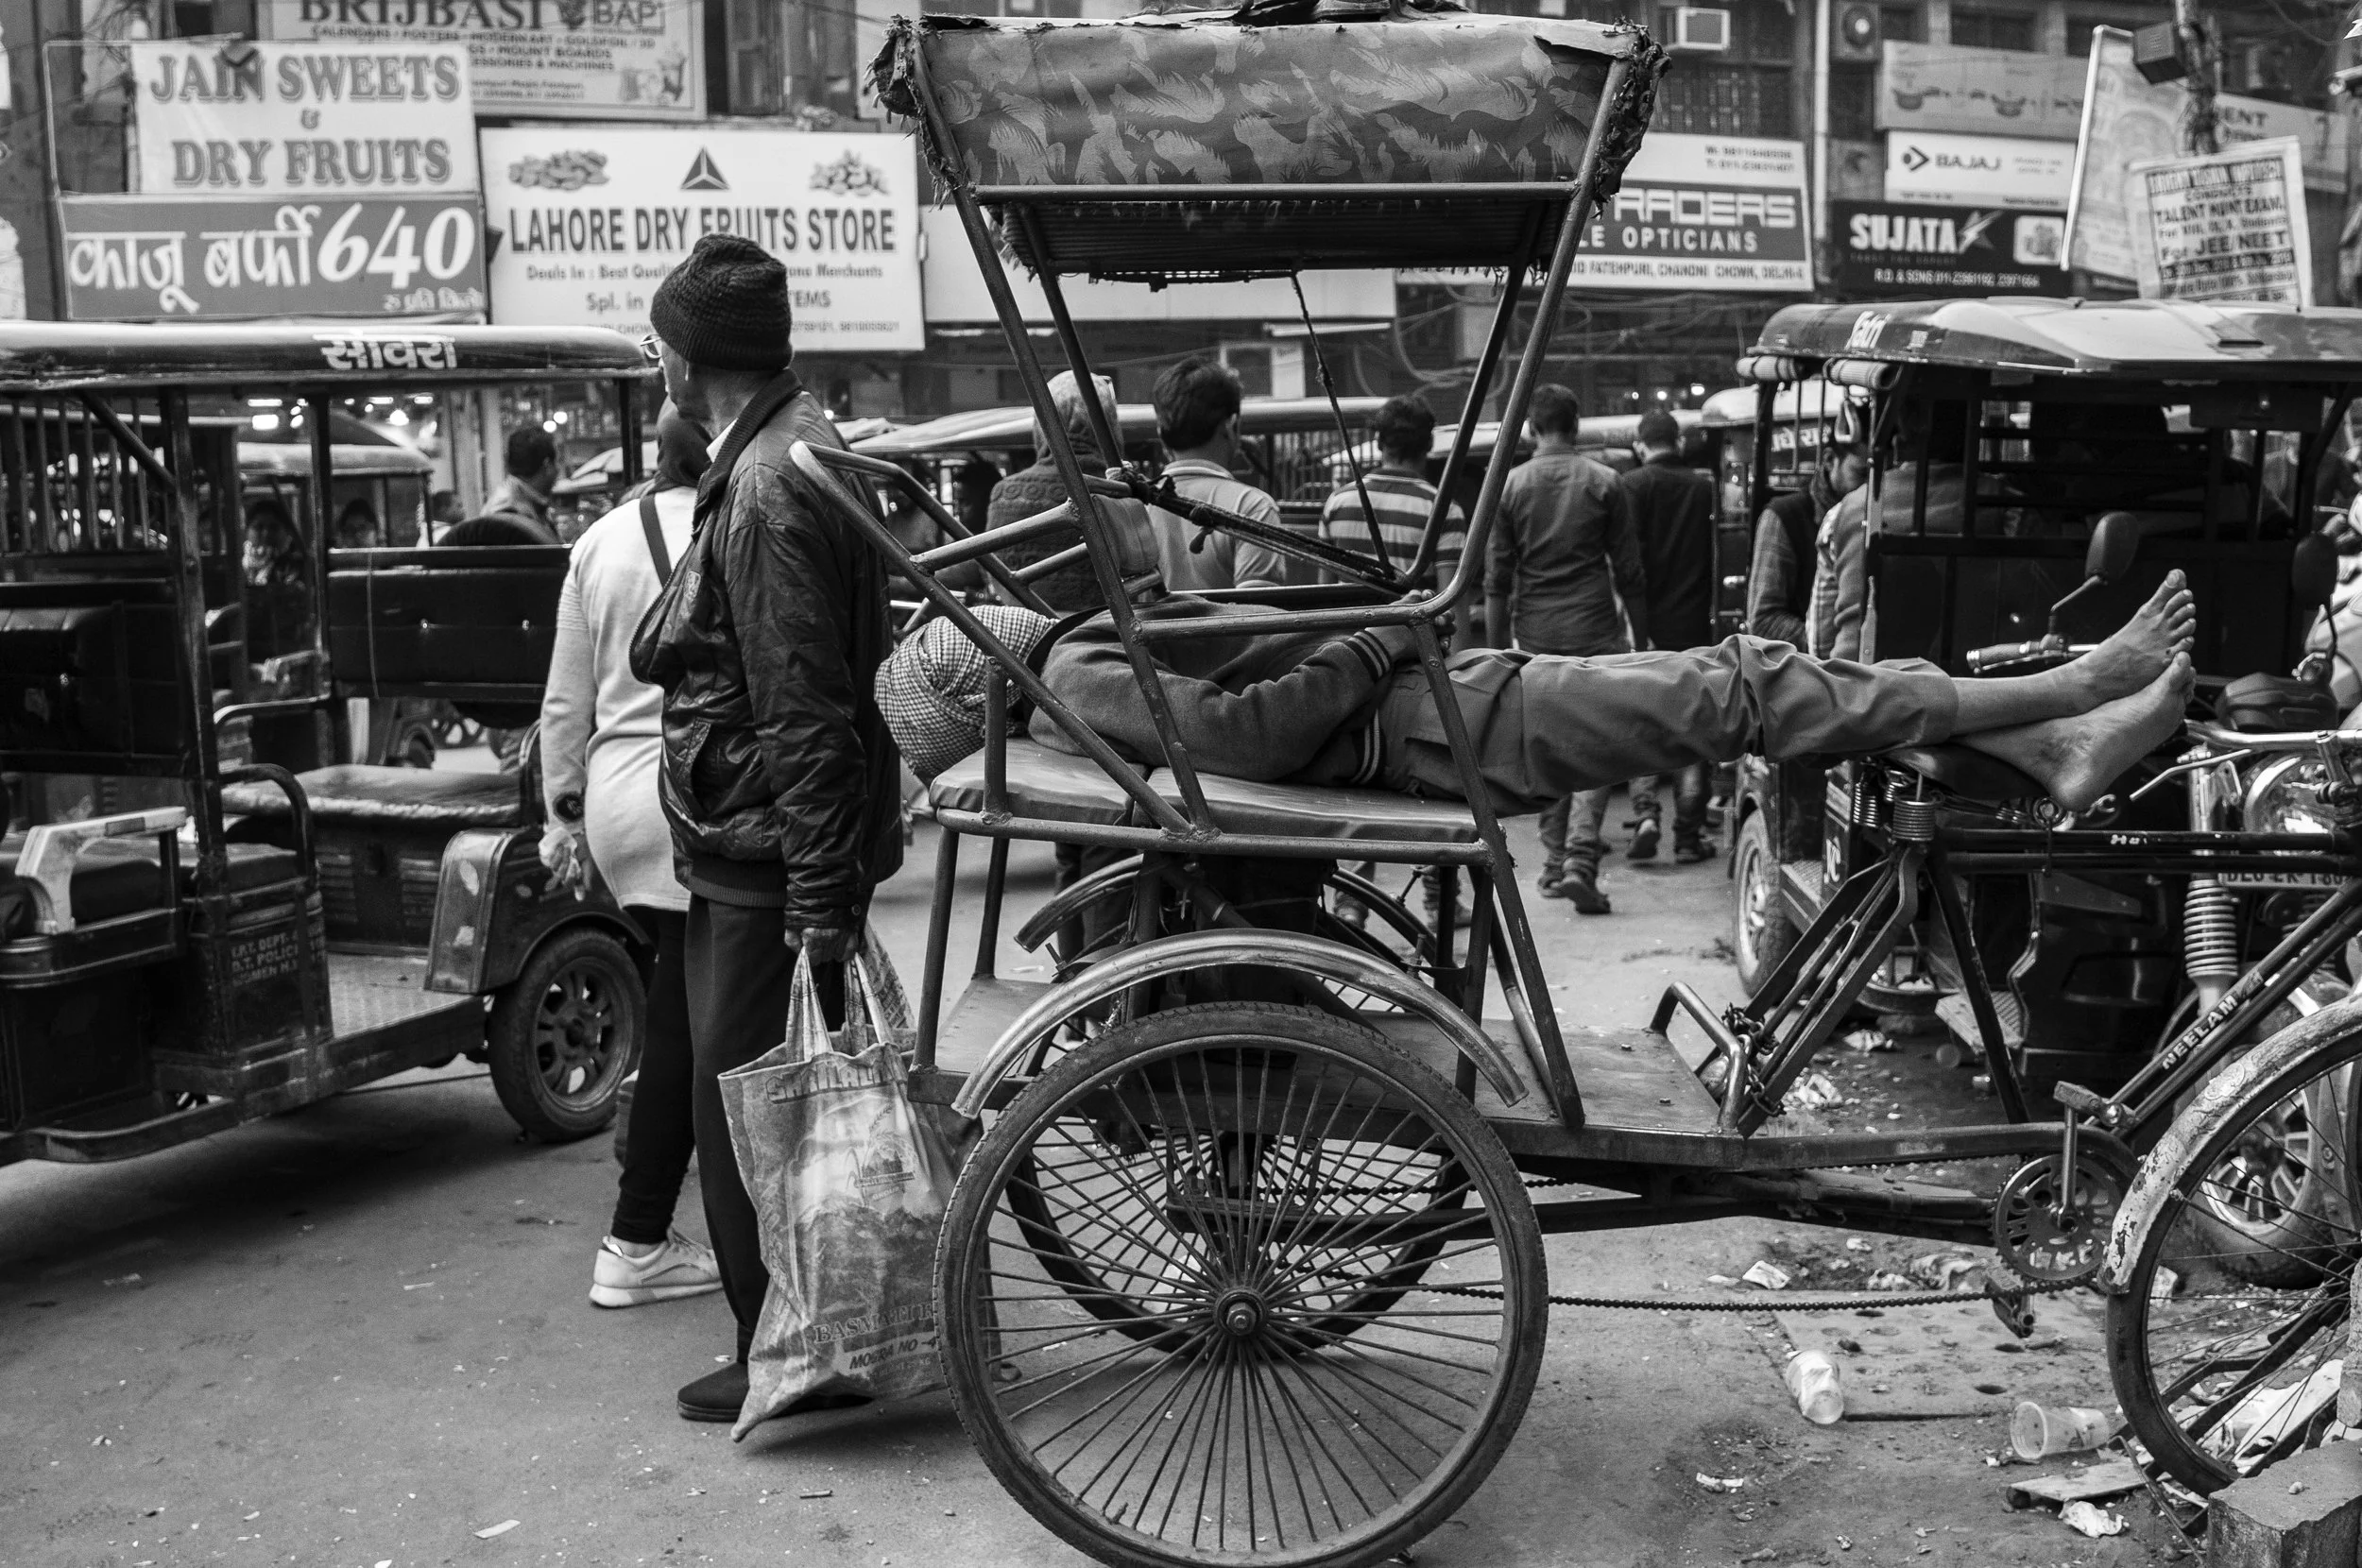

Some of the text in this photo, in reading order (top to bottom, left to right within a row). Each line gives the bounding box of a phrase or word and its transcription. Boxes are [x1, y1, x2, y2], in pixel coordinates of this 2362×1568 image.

[471, 57, 534, 68] ESSORIES
[549, 60, 616, 71] MACHINES
[556, 47, 613, 59] BOARDS
[150, 55, 462, 103] JAIN SWEETS
[173, 139, 453, 186] DRY FRUITS
[1937, 153, 2003, 171] BAJAJ
[1614, 188, 1797, 228] RADERS
[2155, 203, 2206, 223] TALENT
[509, 207, 625, 252] LAHORE
[635, 208, 691, 252] DRY
[808, 208, 896, 251] STORE
[1621, 225, 1758, 252] OPTICIANS
[1849, 213, 1958, 253] SUJATA
[66, 231, 199, 314] काजू
[317, 203, 474, 289] 640
[526, 264, 567, 281] Deals
[597, 264, 629, 281] Best
[815, 263, 883, 279] Merchants
[586, 291, 621, 315] Spl.
[787, 289, 832, 308] TEMS
[2162, 995, 2237, 1069] NEELAM
